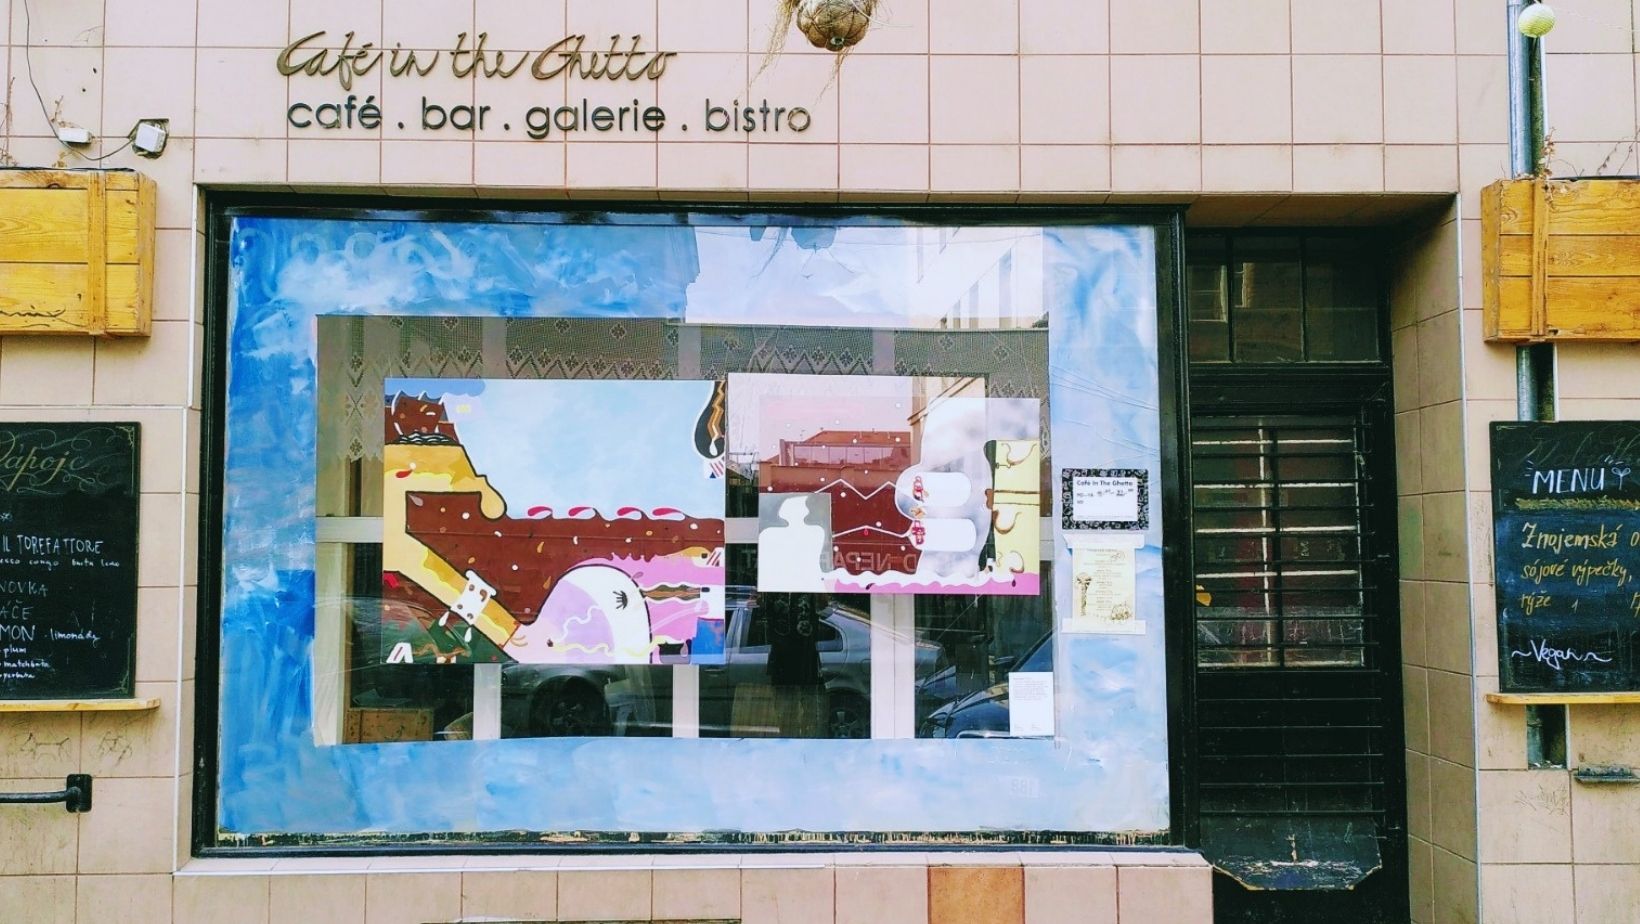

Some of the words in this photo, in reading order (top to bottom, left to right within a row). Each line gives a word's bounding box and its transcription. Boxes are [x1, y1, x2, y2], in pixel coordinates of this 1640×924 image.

[277, 31, 383, 91] Café
[390, 43, 439, 77] in
[450, 32, 530, 78] the
[532, 34, 677, 80] Ghetto
[287, 95, 382, 129] café
[422, 96, 491, 130] bar
[526, 98, 666, 139] galerie
[705, 98, 811, 132] bistro
[1533, 467, 1605, 494] MENU
[1521, 522, 1623, 554] Znojemská
[1521, 559, 1568, 584] sójové
